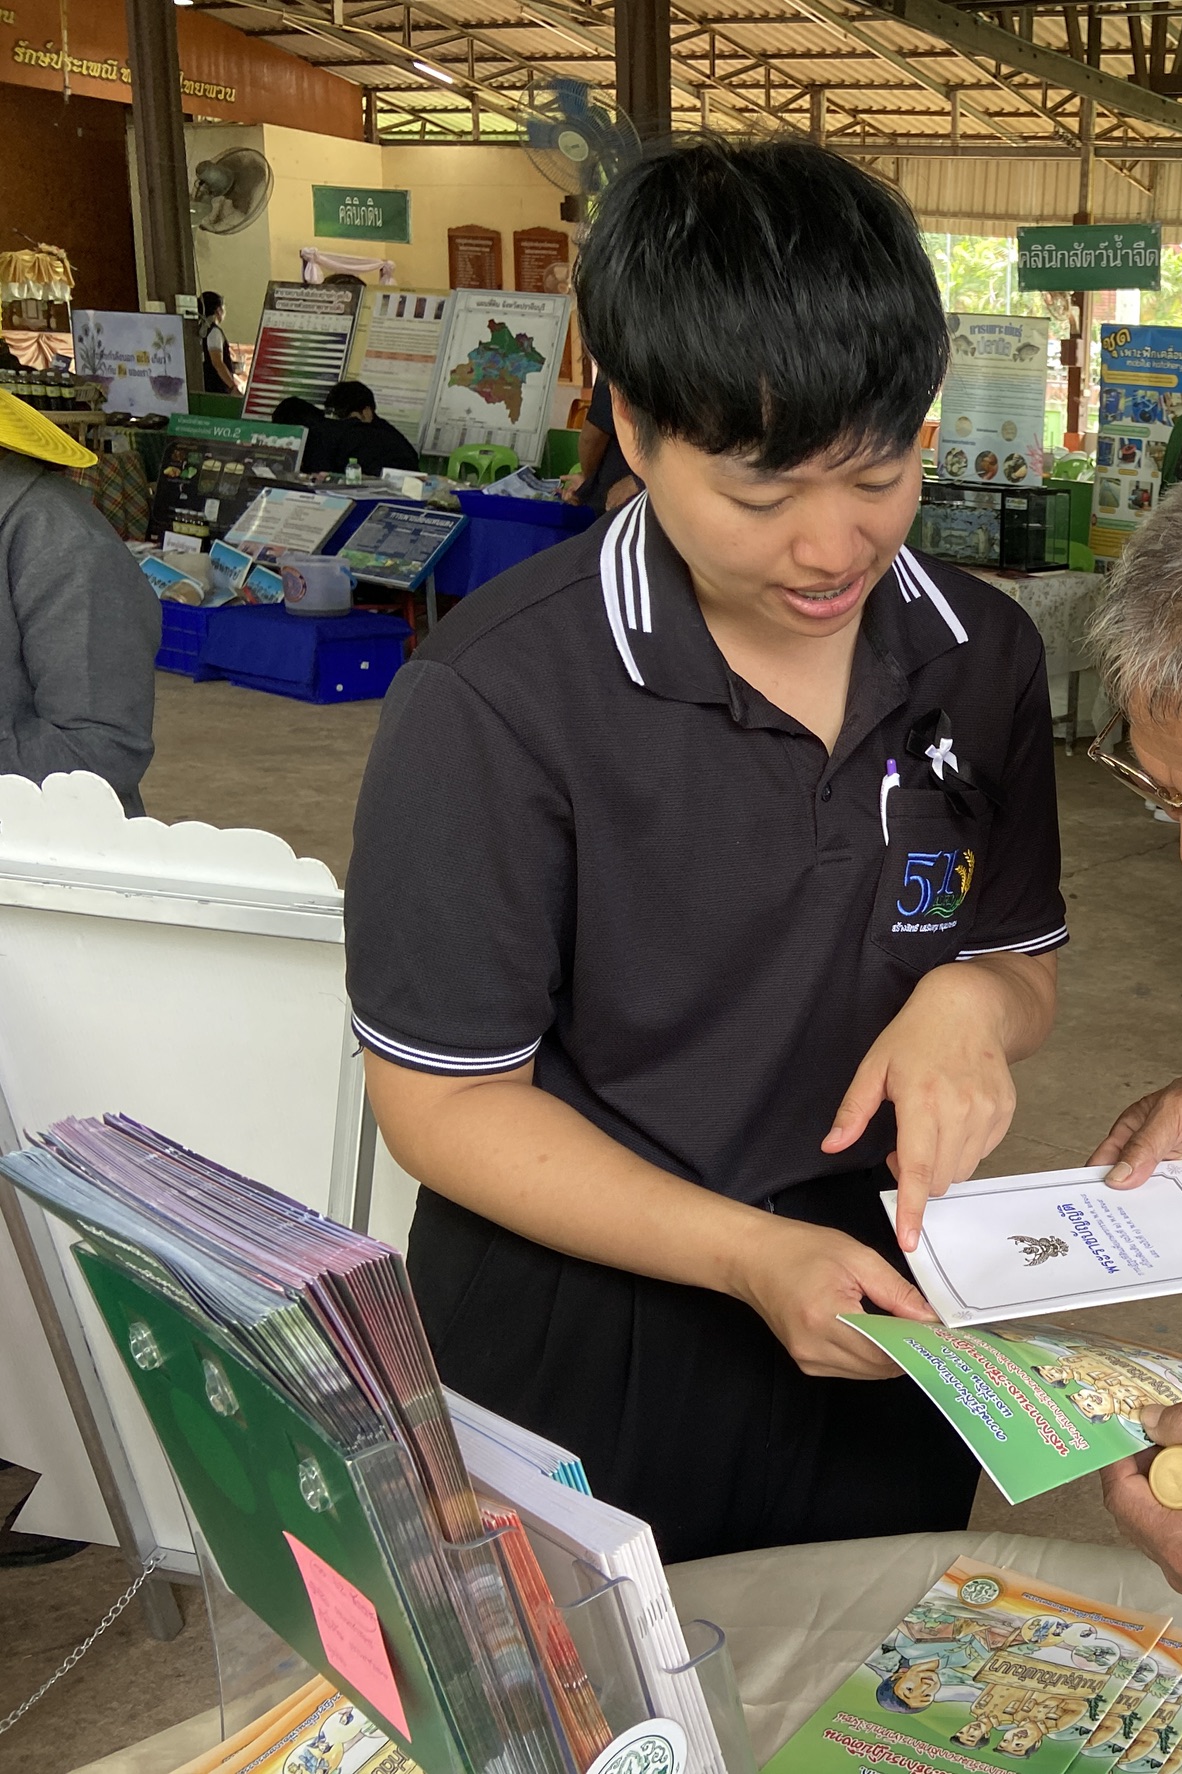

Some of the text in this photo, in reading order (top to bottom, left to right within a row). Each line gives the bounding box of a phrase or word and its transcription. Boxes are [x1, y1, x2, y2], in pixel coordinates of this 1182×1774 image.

[13, 40, 118, 83] รักษ์ประเพณี
[339, 196, 383, 227] คลินิกดิน
[1018, 234, 1159, 268] คลินิกสัตว์น้ำจืด
[1102, 327, 1131, 358] ชุด
[1057, 1203, 1120, 1274] พระราชบัญญัติ
[969, 1374, 1013, 1419] และที่ดิน
[988, 1659, 1106, 1695] บ้านปฏิรูปที่ดินพัฒนา
